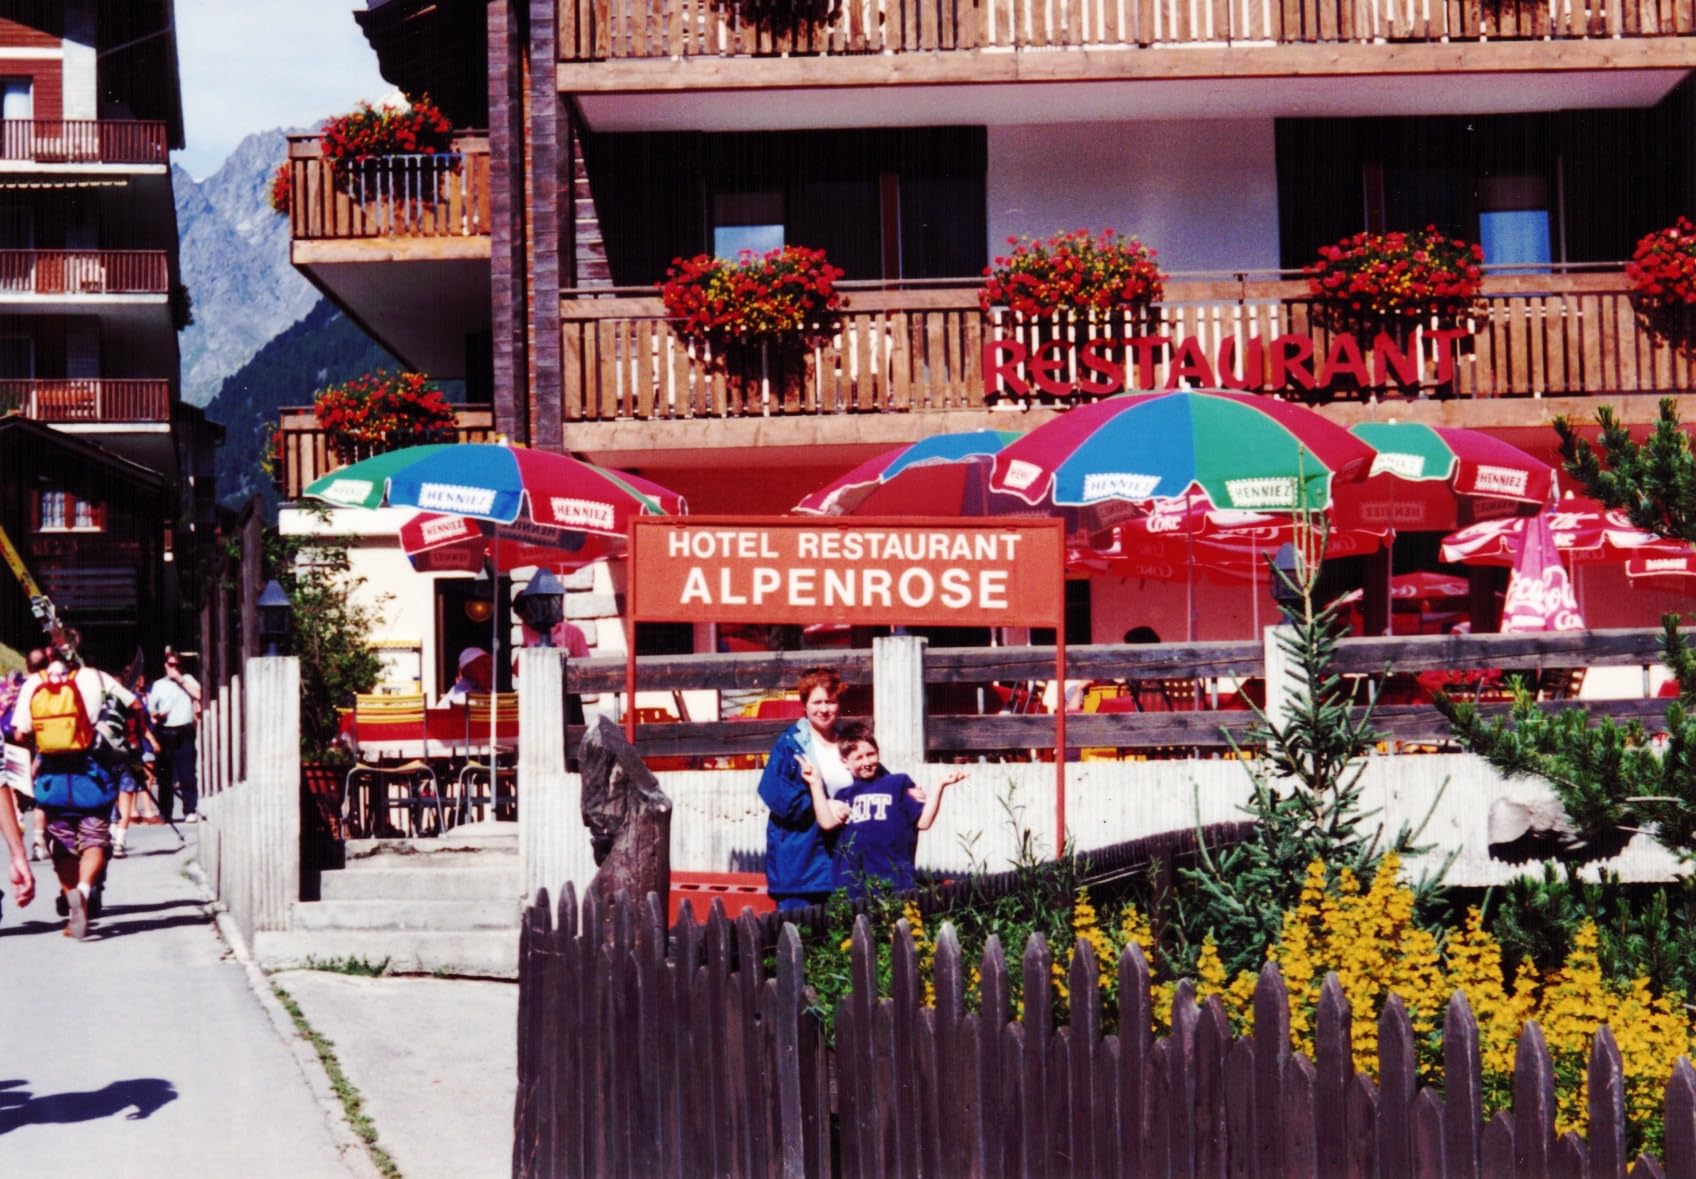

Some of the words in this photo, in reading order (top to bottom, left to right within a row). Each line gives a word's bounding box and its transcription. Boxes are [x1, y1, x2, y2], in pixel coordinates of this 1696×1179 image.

[984, 330, 1468, 396] RESTAURANT
[1091, 478, 1148, 491] HENNIEZ
[1480, 473, 1522, 488] HENNIEZ
[426, 490, 488, 506] HENNIEZ
[1234, 485, 1291, 498] HENNIEZ
[556, 504, 609, 522] HENNIEZ
[668, 531, 779, 559] HOTEL
[799, 532, 1021, 561] RESTAURANT
[680, 567, 1009, 609] ALPENROSE
